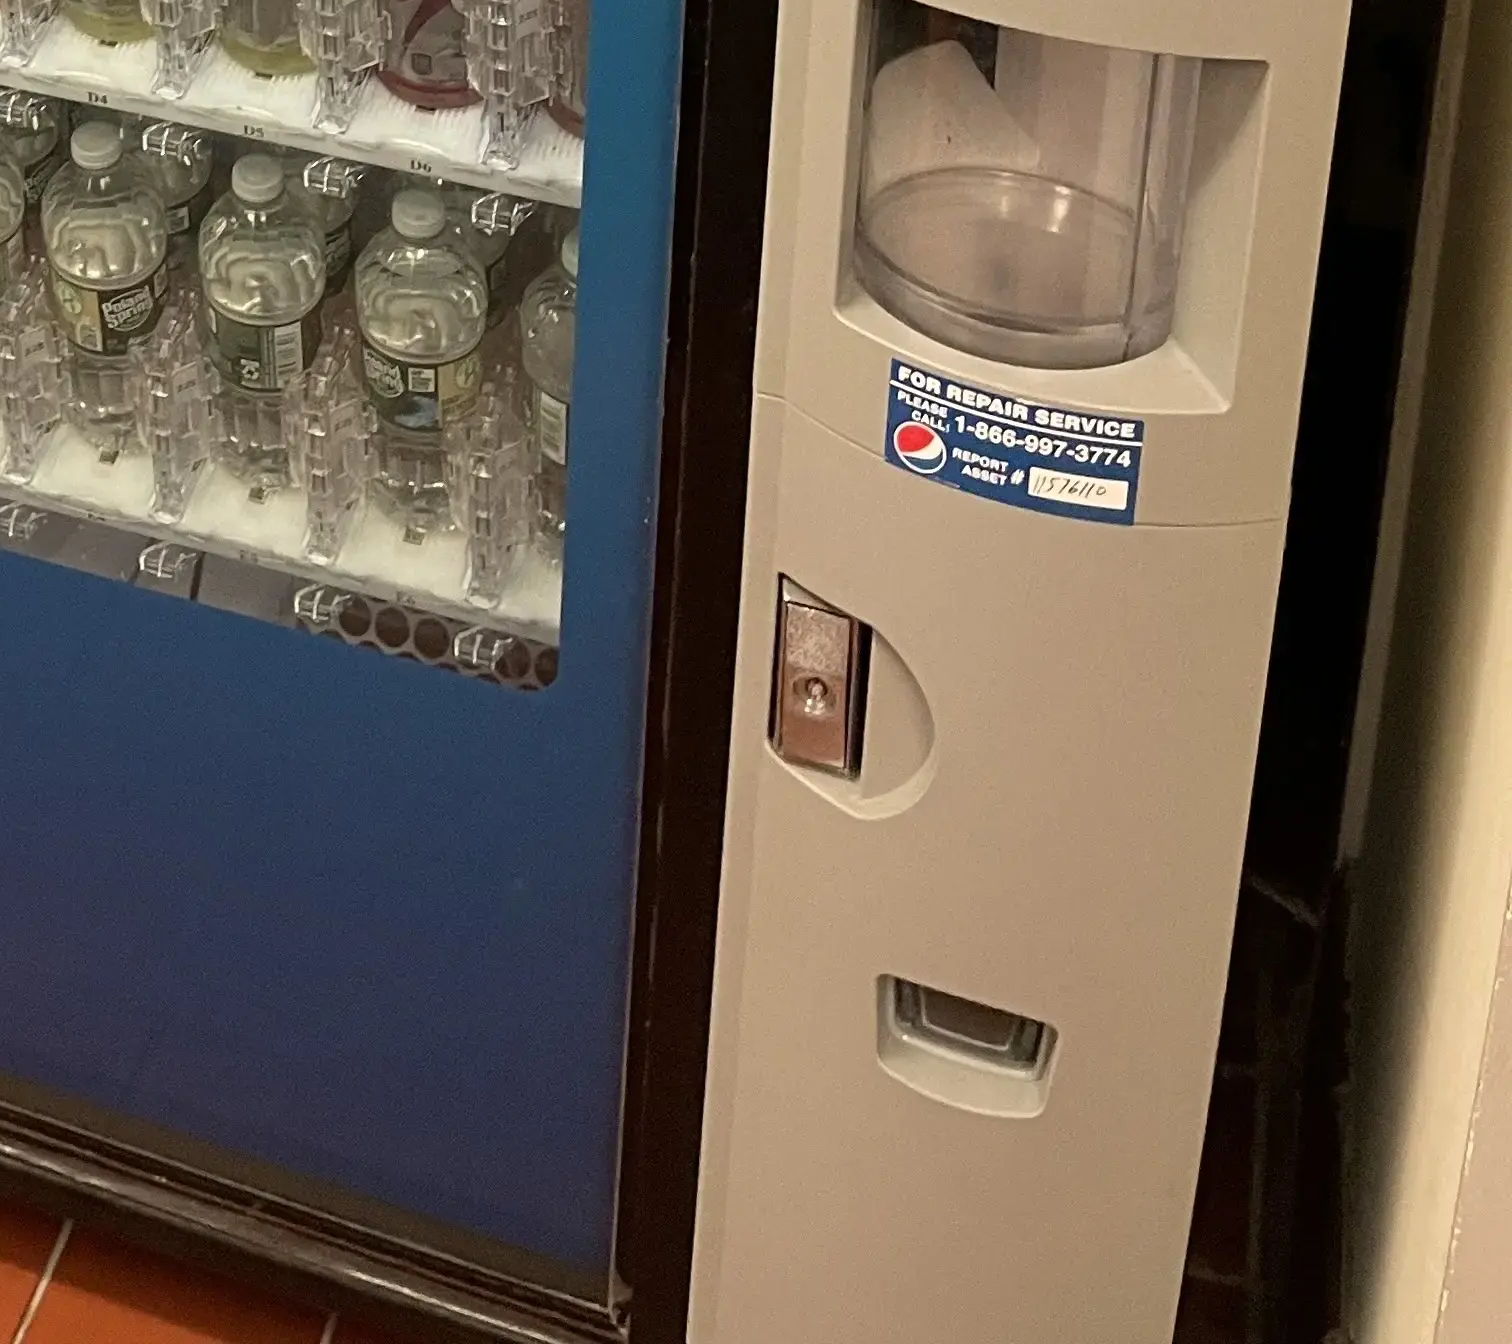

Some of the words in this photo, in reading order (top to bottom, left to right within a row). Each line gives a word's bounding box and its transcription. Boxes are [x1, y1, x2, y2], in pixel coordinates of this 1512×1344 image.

[88, 92, 109, 105] D4
[243, 124, 264, 138] D5
[410, 160, 432, 173] D6
[102, 285, 151, 313] Poland
[105, 298, 155, 329] Spring
[897, 390, 948, 419] PLEASE
[898, 365, 942, 395] FOR
[946, 383, 1030, 421] REPAIR
[1034, 408, 1136, 438] SERVICE
[954, 415, 1131, 468] 1-866-997-3774
[952, 447, 1009, 473] REPORT
[961, 465, 1008, 486] ASSET
[1010, 468, 1024, 485] #
